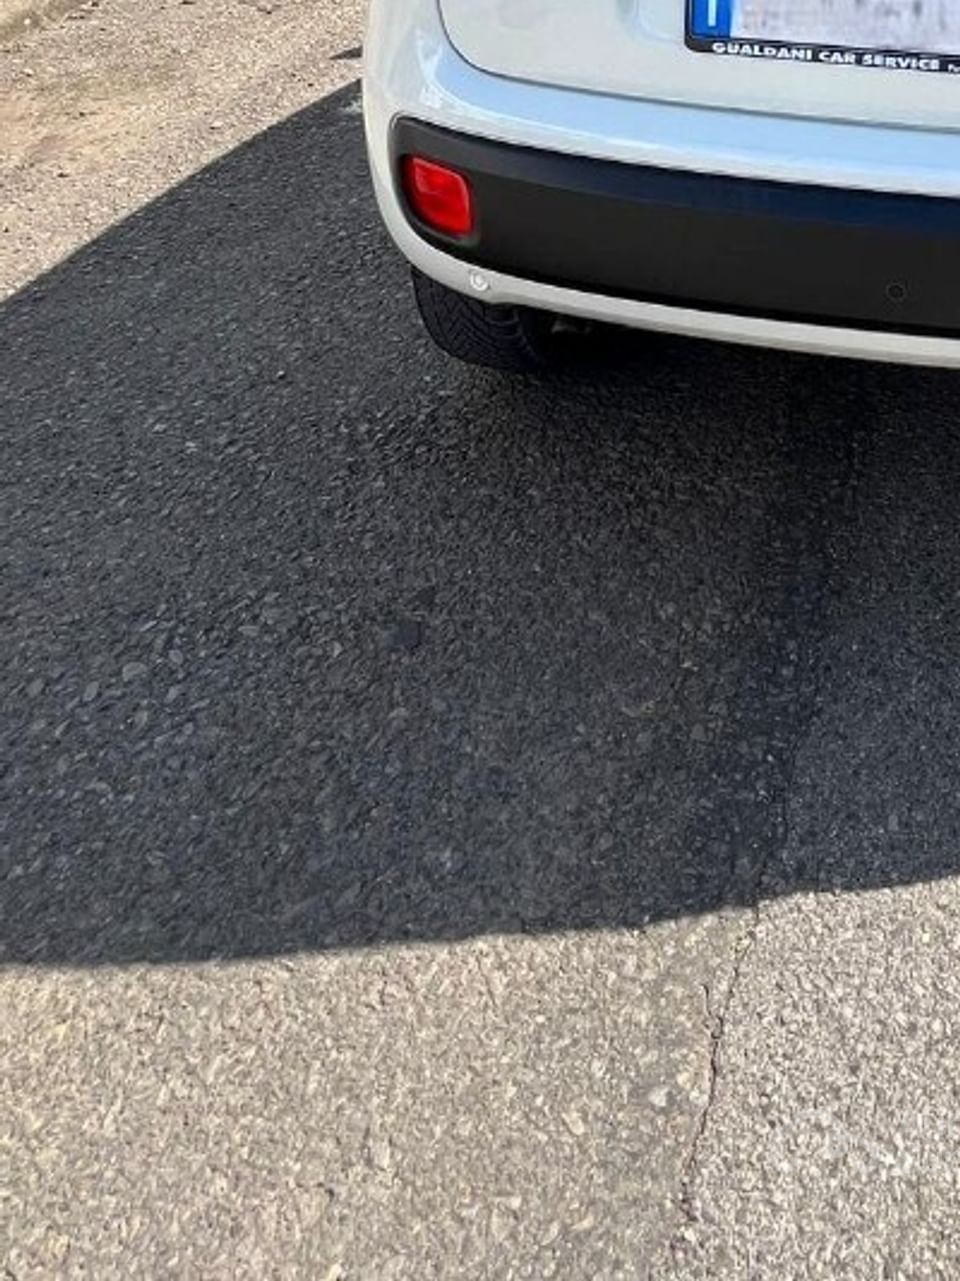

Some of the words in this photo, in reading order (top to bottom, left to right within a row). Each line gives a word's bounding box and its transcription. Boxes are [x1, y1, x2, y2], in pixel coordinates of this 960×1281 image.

[712, 42, 813, 61] GUALDANI
[818, 50, 856, 65] CAR
[862, 54, 940, 70] SERVICE
